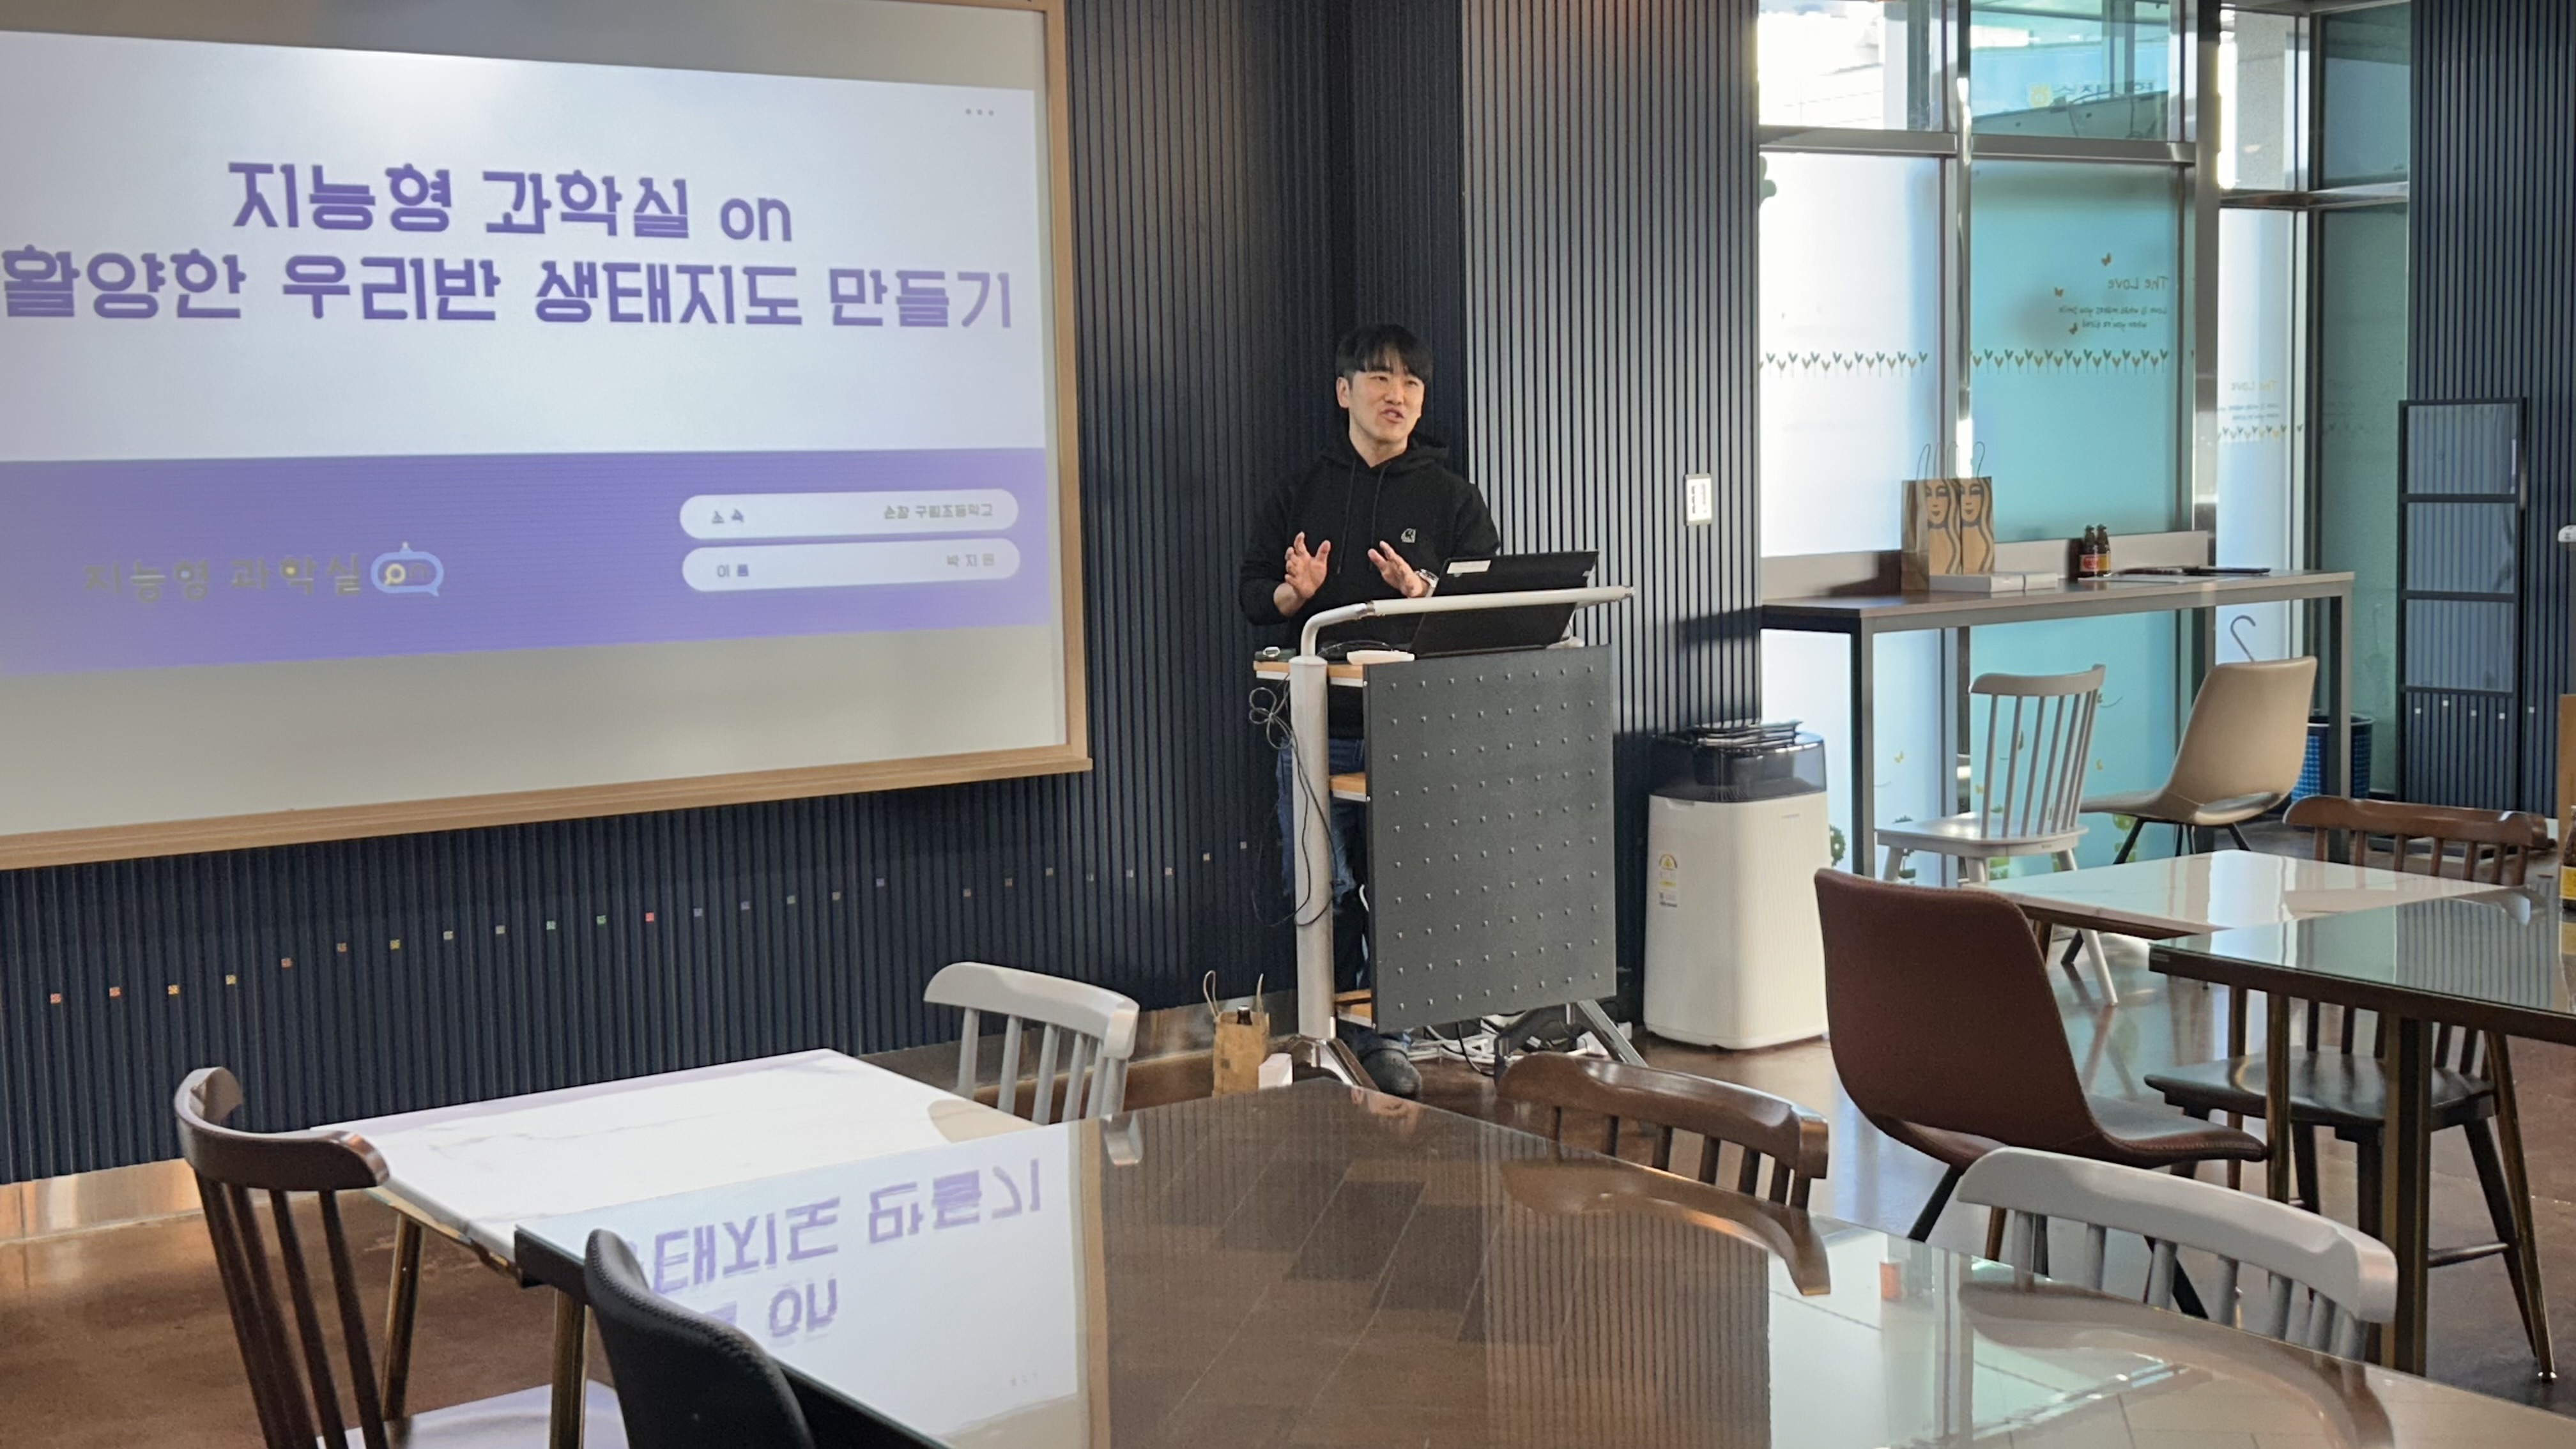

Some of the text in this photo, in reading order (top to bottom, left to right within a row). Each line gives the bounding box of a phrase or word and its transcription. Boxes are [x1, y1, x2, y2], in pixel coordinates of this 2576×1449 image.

[228, 162, 792, 241] 지능형 과학실 on
[2, 244, 1011, 328] 활양한 우리반 생태지도 만들기
[83, 557, 210, 603] 지능형
[230, 553, 361, 597] 과학실
